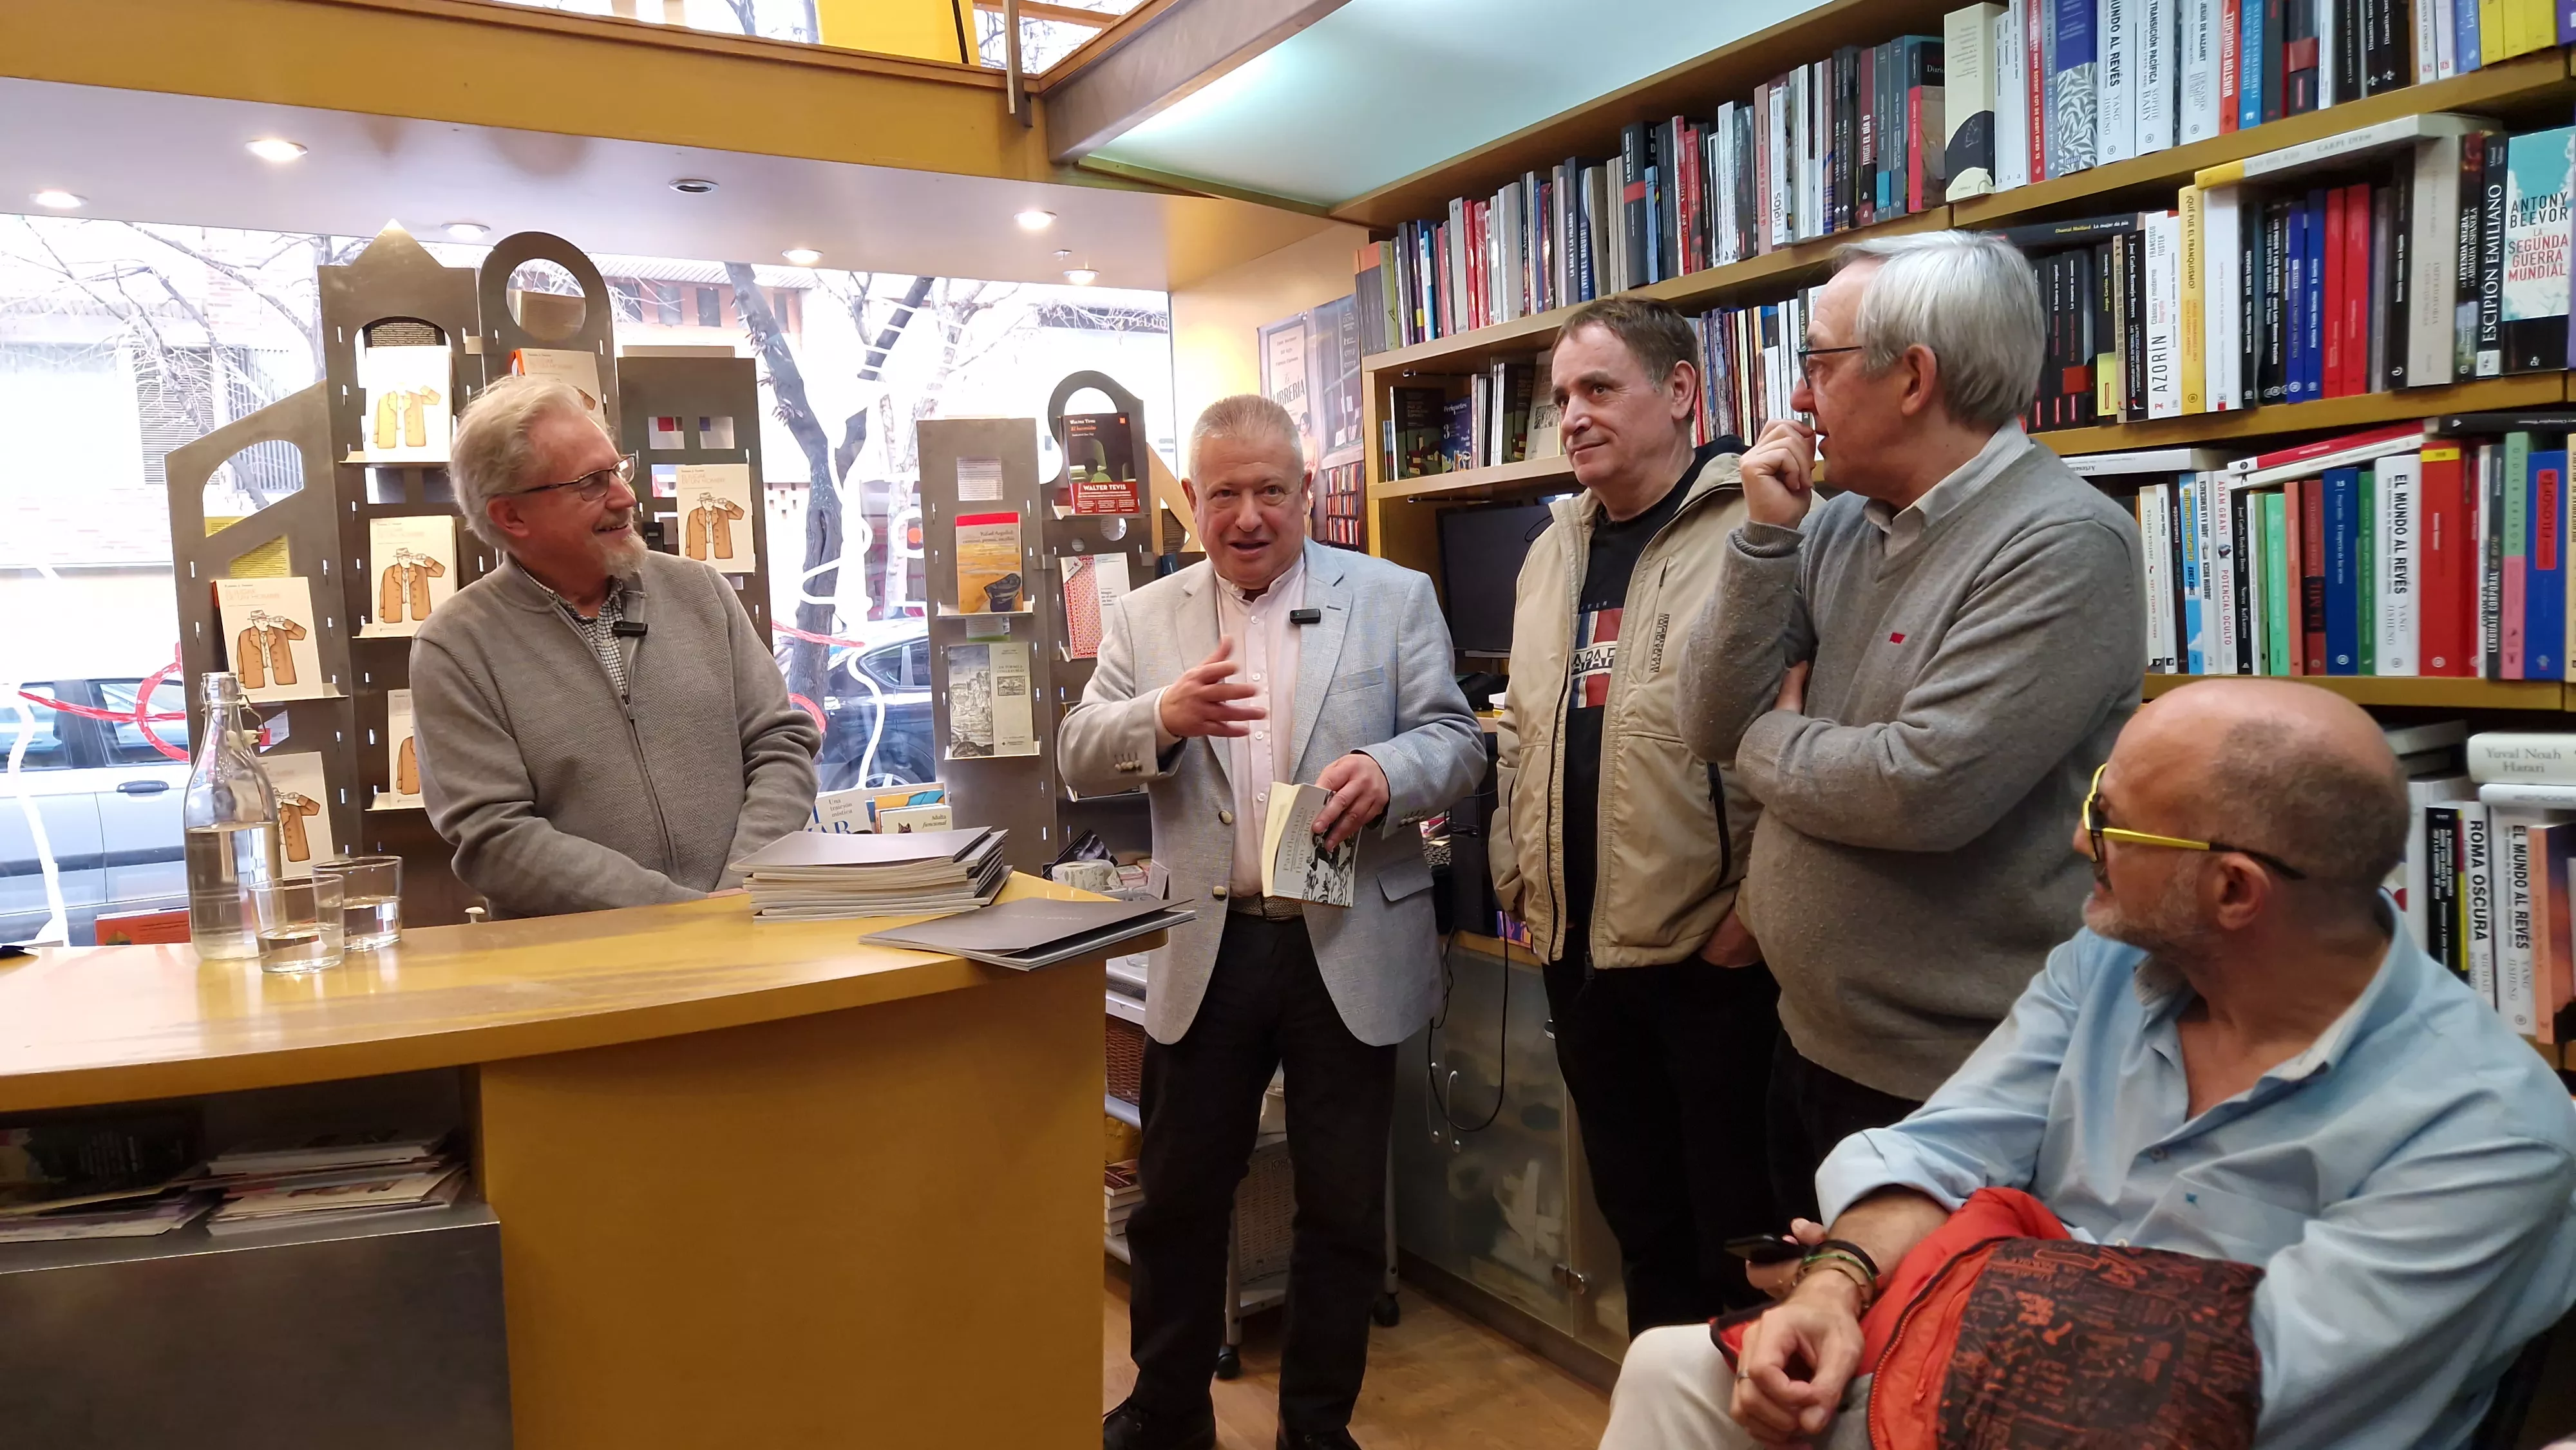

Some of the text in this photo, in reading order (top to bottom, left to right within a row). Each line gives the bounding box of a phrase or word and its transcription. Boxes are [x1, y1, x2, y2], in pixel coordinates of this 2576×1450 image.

[2200, 23, 2206, 32] DE
[2110, 37, 2119, 50] AL
[2148, 2, 2160, 84] TRANSICIÓN PACÍFICA
[2223, 11, 2234, 97] WINSTON CHURCHILL
[2110, 53, 2123, 86] REVÉS
[1861, 120, 1871, 165] TRIGO EL DÍA
[1772, 193, 1783, 227] riglos
[2186, 196, 2196, 213] ¿QUÉ
[2511, 191, 2568, 214] ANTONY
[2460, 217, 2469, 244] NEGRA
[2468, 207, 2477, 245] ESPAÑOLA
[2510, 209, 2568, 229] BEEVOR
[2533, 228, 2543, 236] LA
[2508, 234, 2568, 254] SEGUNDA
[2512, 250, 2563, 268] GUERRA
[1580, 259, 1587, 268] EL
[2187, 240, 2196, 288] FRANQUISMO?
[2459, 245, 2468, 280] LEYENDA
[2468, 246, 2477, 278] ARMADA
[2480, 184, 2502, 342] ESCIPIÓN EMILIANO
[2508, 265, 2567, 283] MUNDIAL
[2149, 335, 2168, 392] AZORÍN
[1273, 376, 1305, 406] LIBRERÍA
[1443, 424, 1450, 439] 3
[2199, 481, 2208, 511] DEMOCRACIA
[2541, 473, 2553, 538] FILOSOFÍA
[2394, 475, 2410, 594] EL MUNDO AL REVÉS
[2217, 481, 2232, 645] ADAM GRANT POTENCIAL OCULTO
[2398, 605, 2407, 632] YANG
[2487, 571, 2499, 652] LENGUAJE CORPORAL
[1649, 613, 1670, 673] NAPAPIJRI
[2485, 748, 2561, 760] Yuval Noah
[2503, 761, 2545, 773] Harari
[831, 809, 853, 818] mística
[922, 820, 947, 829] funcional
[1296, 810, 1315, 873] Iban Zaldua
[2470, 821, 2488, 940] ROMA OSCURA
[2513, 825, 2533, 949] EL MUNDO AL REVÉS
[2521, 961, 2530, 989] YANG
